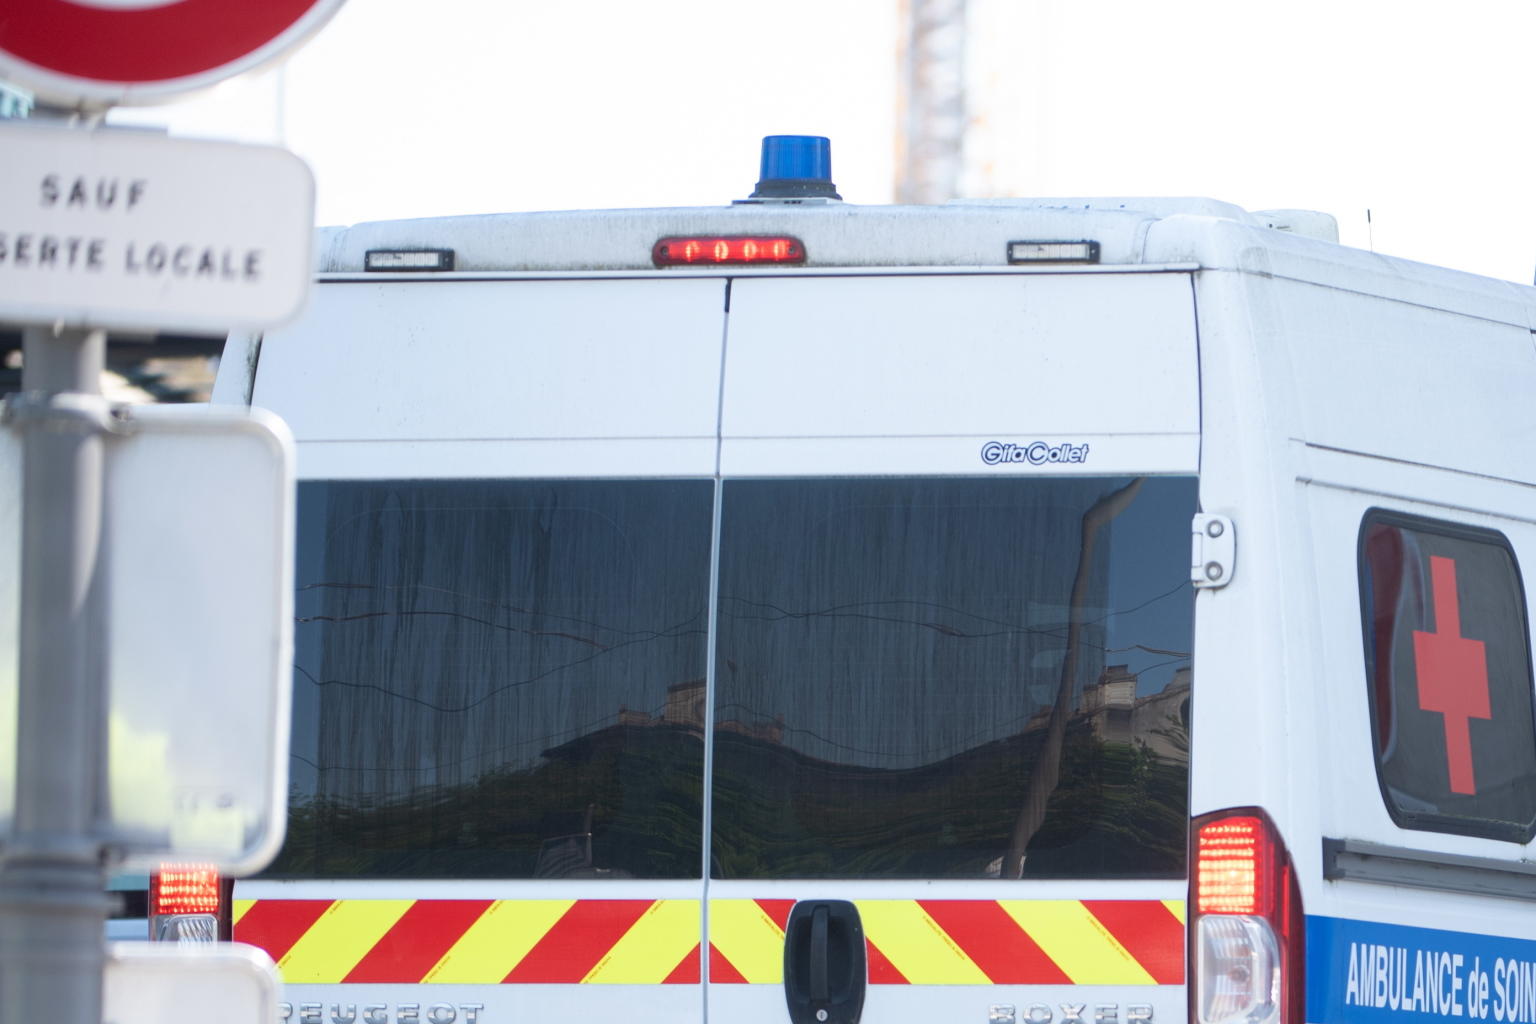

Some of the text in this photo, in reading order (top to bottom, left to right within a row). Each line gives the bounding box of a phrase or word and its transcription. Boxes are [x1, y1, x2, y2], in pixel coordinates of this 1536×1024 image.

[40, 173, 147, 212] SAUF
[125, 242, 263, 282] LOCALE
[1345, 942, 1463, 1016] AMBULANCE
[1468, 957, 1489, 1021] de
